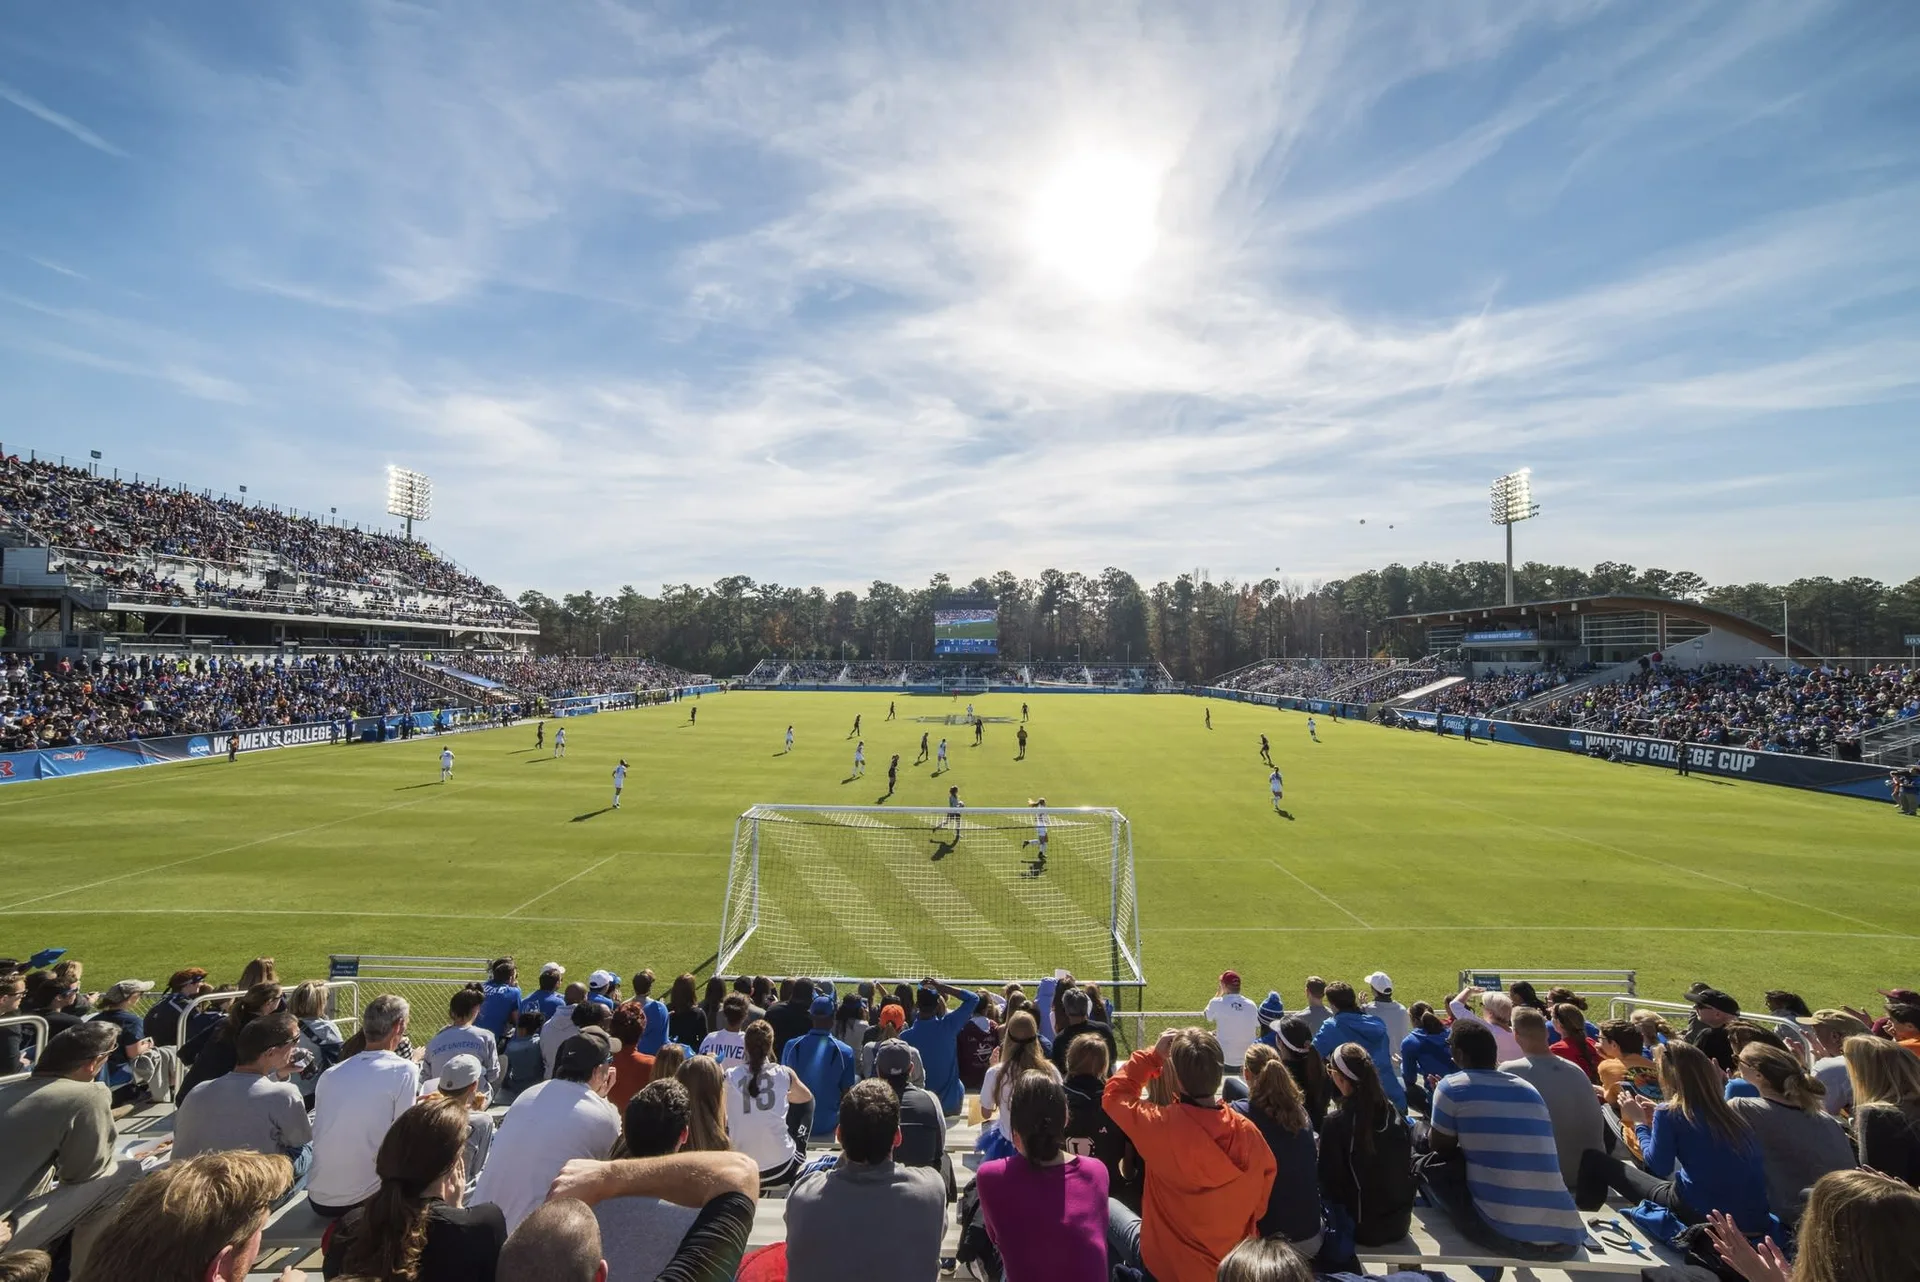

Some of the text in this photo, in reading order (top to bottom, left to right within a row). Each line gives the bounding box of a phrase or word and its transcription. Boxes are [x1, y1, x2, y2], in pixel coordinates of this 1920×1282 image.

[284, 726, 331, 745] COLLEGE
[1649, 743, 1715, 767] COLGE
[1718, 751, 1755, 772] CUP
[738, 1072, 776, 1115] 13
